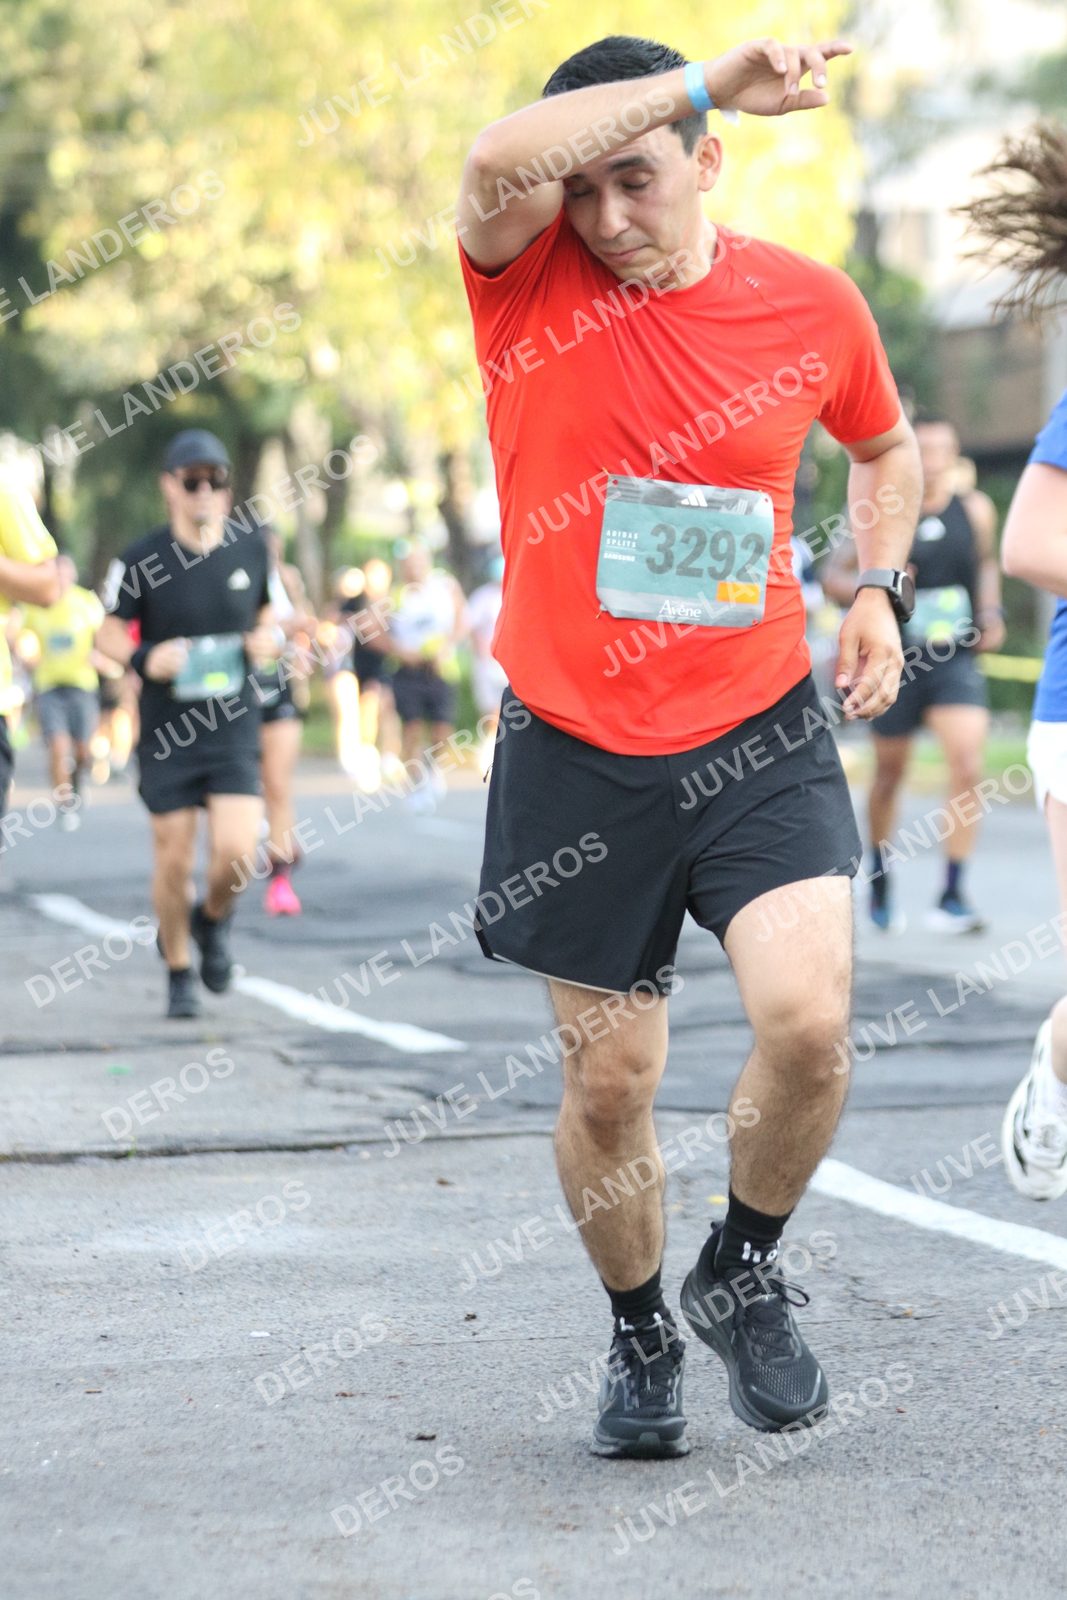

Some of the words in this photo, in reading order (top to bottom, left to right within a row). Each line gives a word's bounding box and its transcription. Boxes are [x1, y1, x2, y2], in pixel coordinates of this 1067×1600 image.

[606, 530, 639, 540] ADIDAS
[606, 538, 637, 548] SPLITS
[645, 523, 765, 583] 3292
